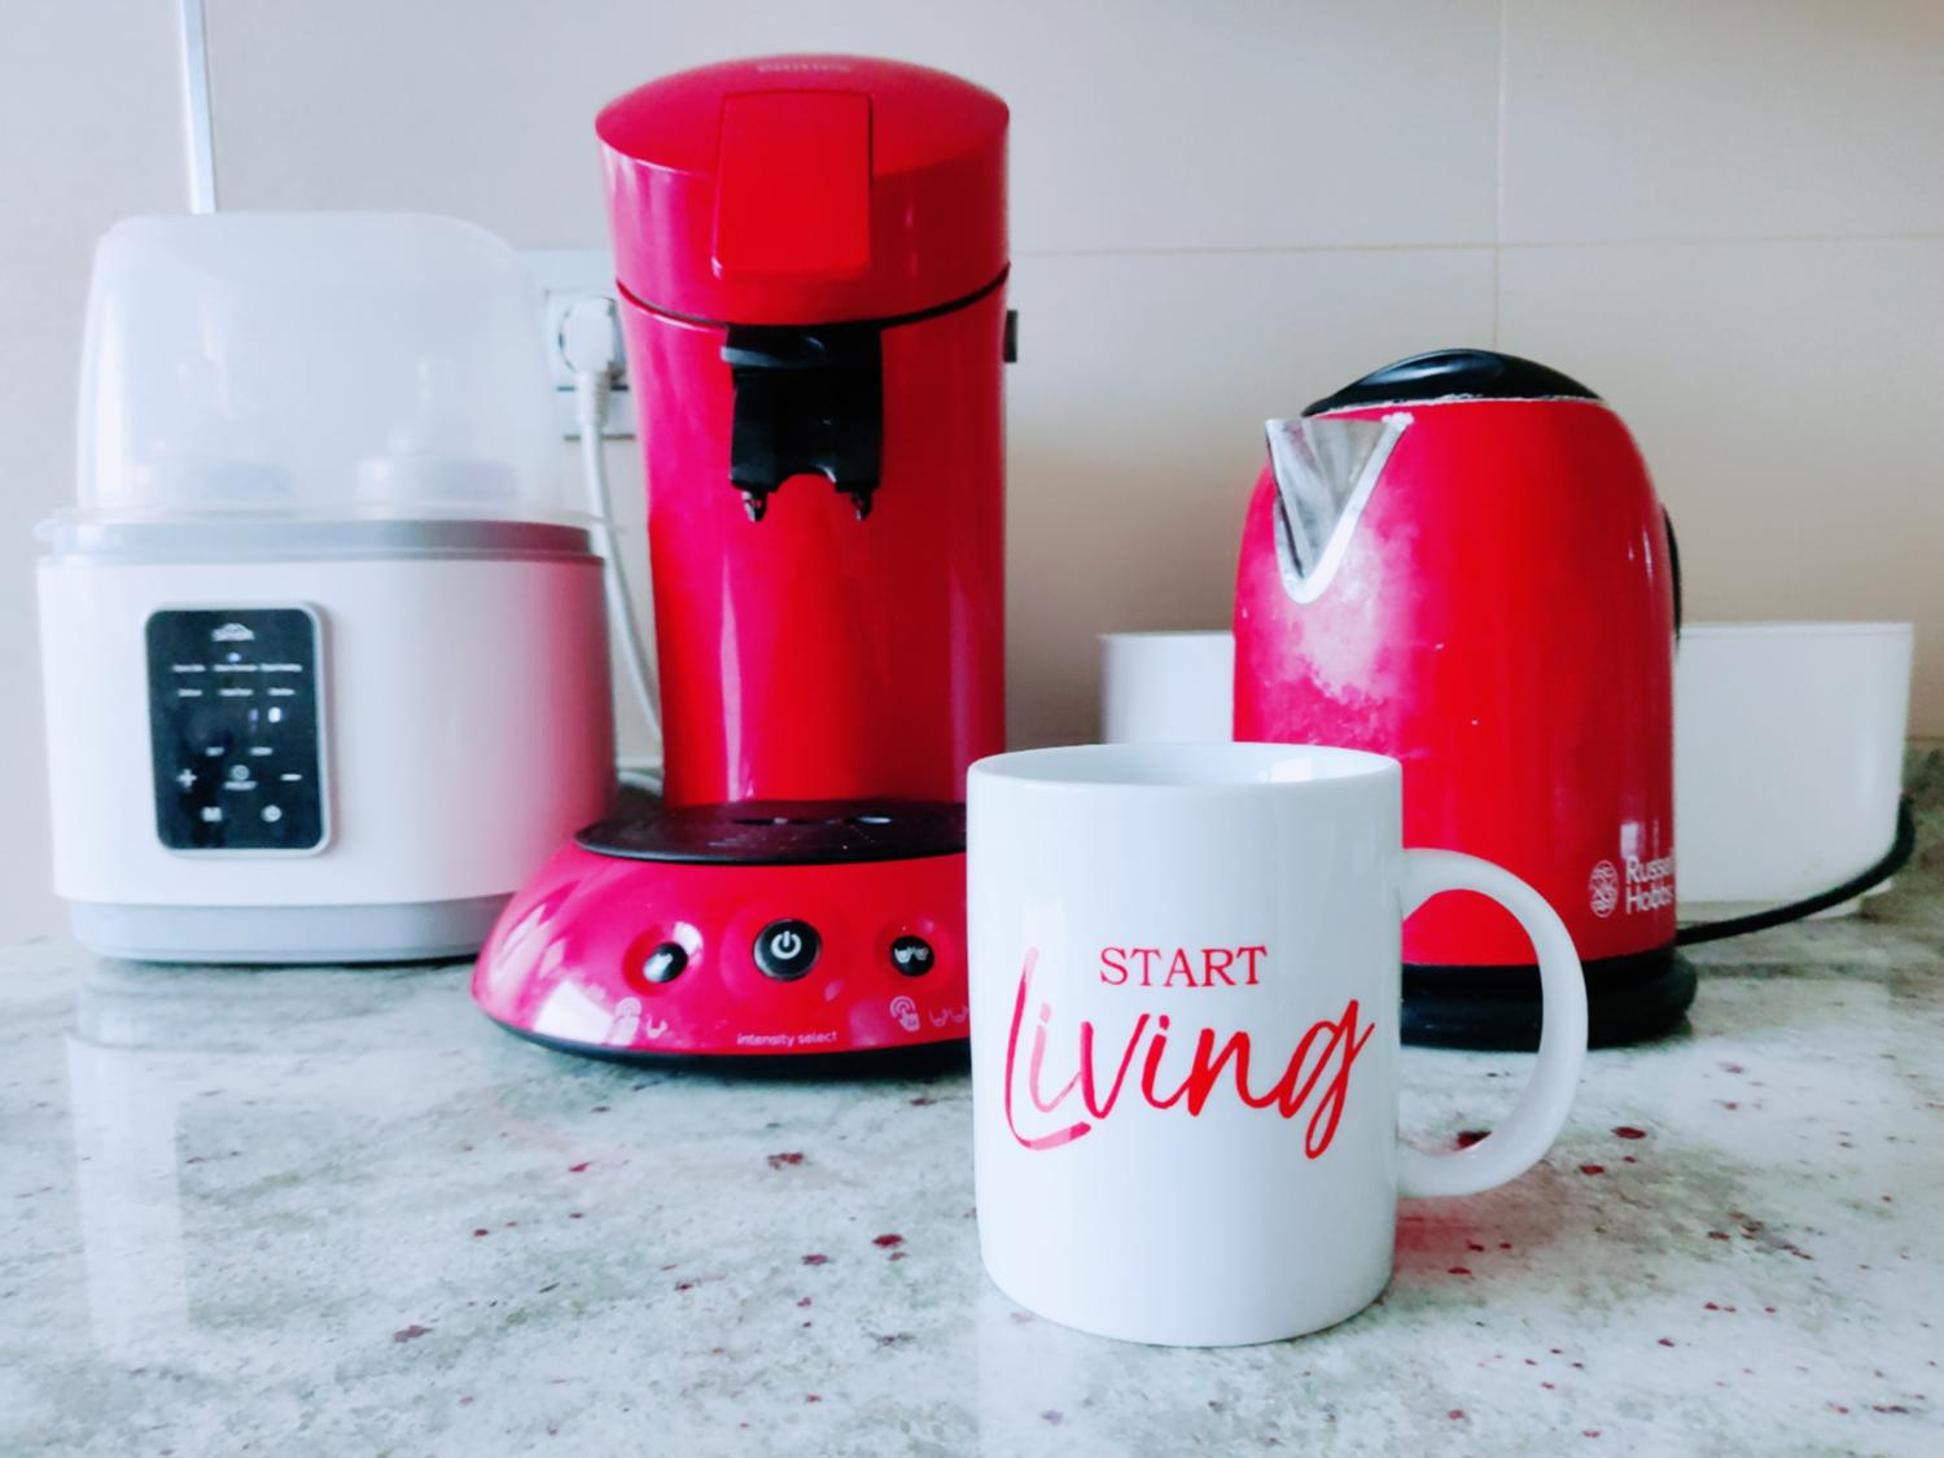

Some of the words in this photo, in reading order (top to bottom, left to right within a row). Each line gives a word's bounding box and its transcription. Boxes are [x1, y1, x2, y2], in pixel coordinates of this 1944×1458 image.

[1099, 946, 1268, 987] START
[736, 1032, 796, 1049] intensity
[797, 1030, 837, 1045] select
[1005, 946, 1375, 1159] Living
